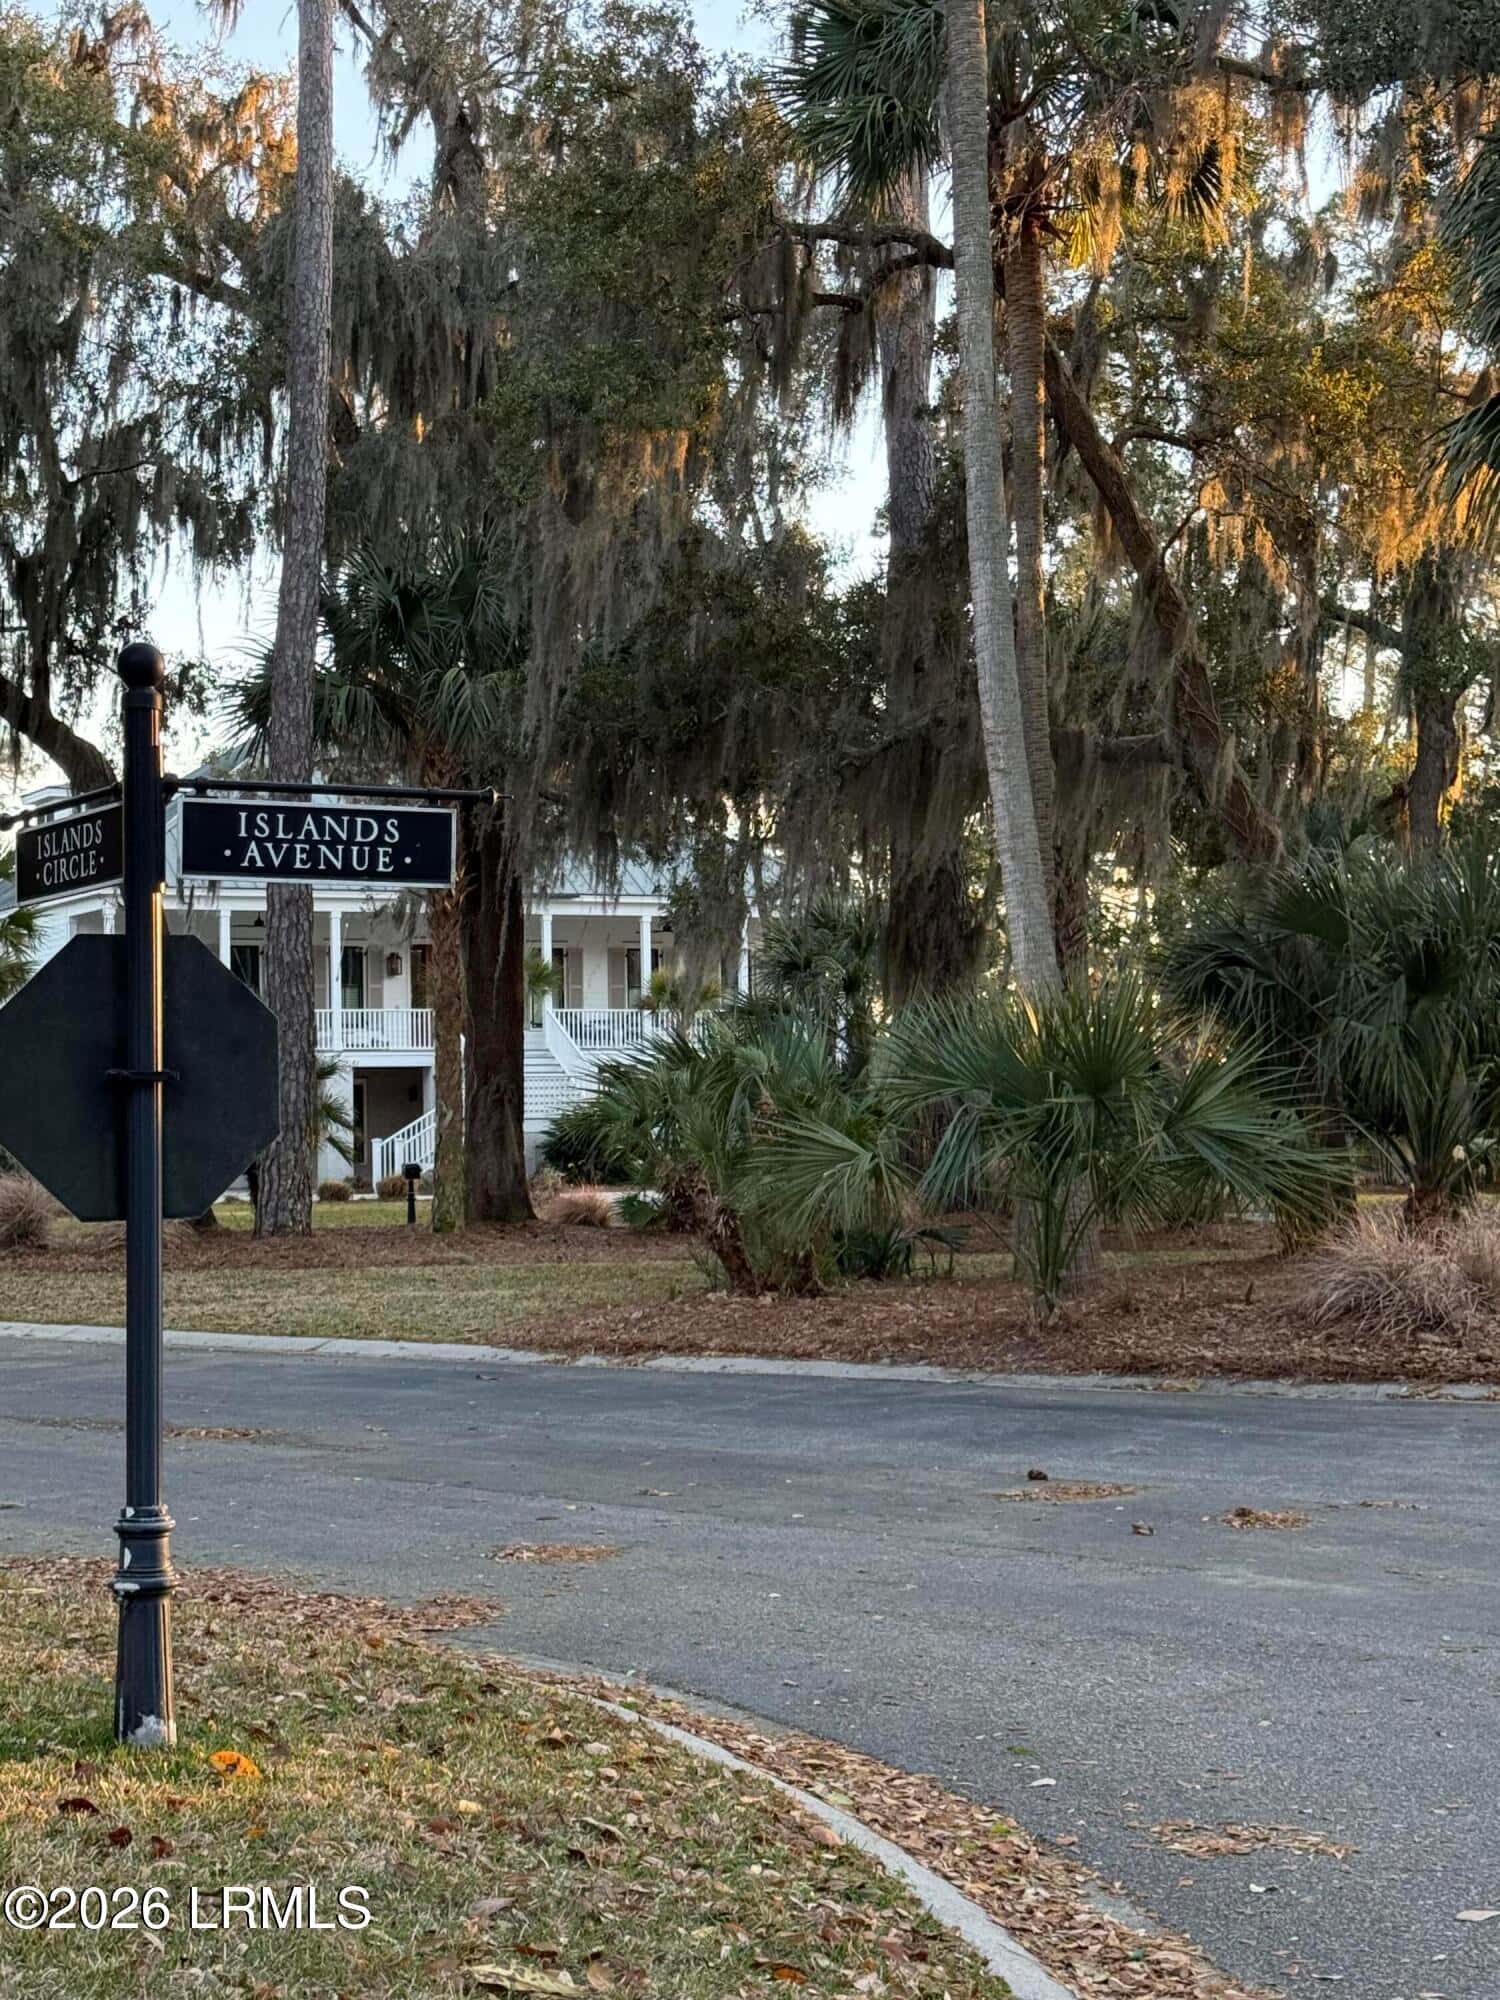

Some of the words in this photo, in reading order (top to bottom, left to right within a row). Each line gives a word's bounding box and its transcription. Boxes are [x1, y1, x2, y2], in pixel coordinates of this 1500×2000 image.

[37, 819, 102, 860] ISLANDS
[238, 812, 400, 843] ISLANDS
[43, 850, 97, 886] CIRCLE
[240, 840, 394, 872] AVENUE
